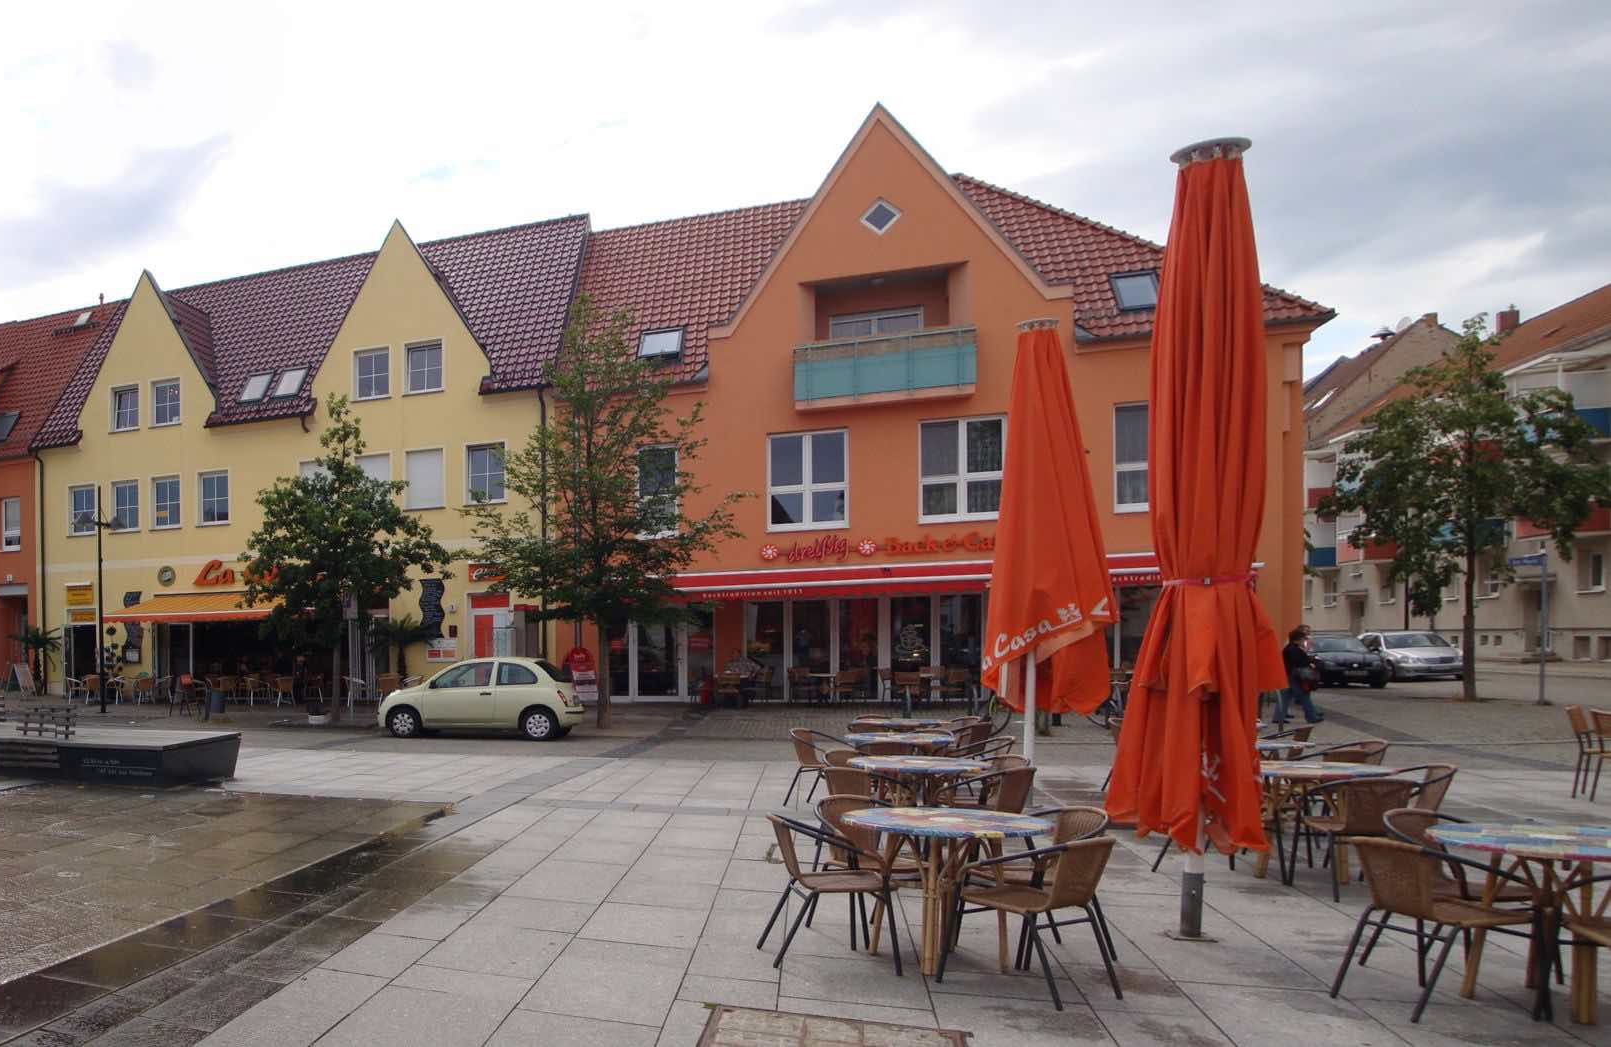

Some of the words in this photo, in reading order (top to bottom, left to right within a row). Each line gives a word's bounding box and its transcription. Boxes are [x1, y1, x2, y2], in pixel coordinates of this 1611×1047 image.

[788, 535, 850, 562] dreißig
[884, 533, 938, 556] Back
[963, 531, 995, 552] Ca
[194, 560, 235, 586] La
[994, 618, 1054, 658] Casa
